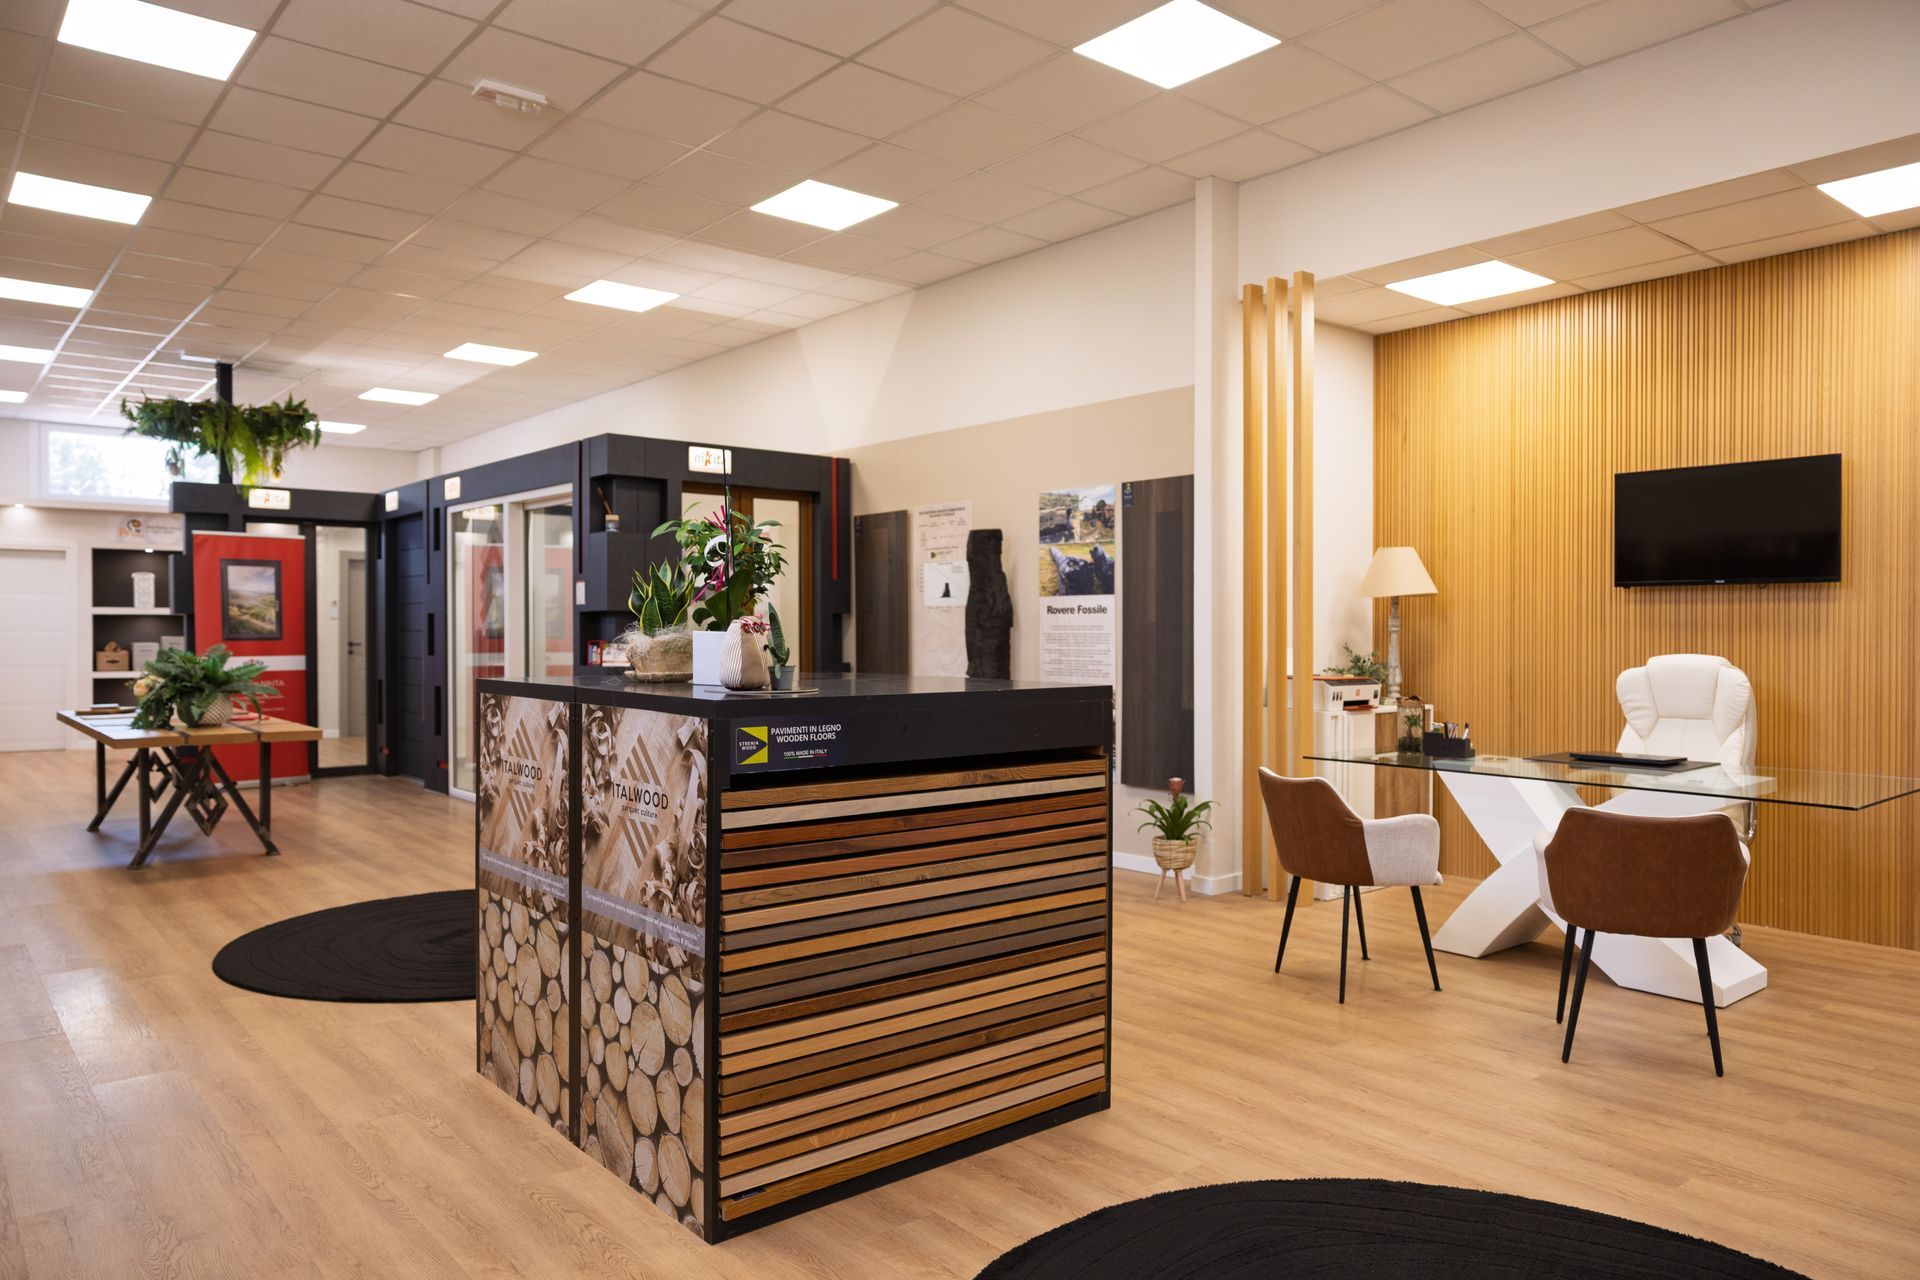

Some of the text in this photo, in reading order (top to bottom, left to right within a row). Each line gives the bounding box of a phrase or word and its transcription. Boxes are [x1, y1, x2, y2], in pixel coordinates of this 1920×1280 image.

[1047, 604, 1107, 615] Rovere Fossile
[771, 724, 842, 735] PAVIMENTI IN LEGNO
[776, 732, 836, 743] WOODEN FLOORS
[501, 759, 543, 781] ITALWOOD
[612, 783, 669, 810] ITALWOOD
[621, 804, 658, 819] parquet culture
